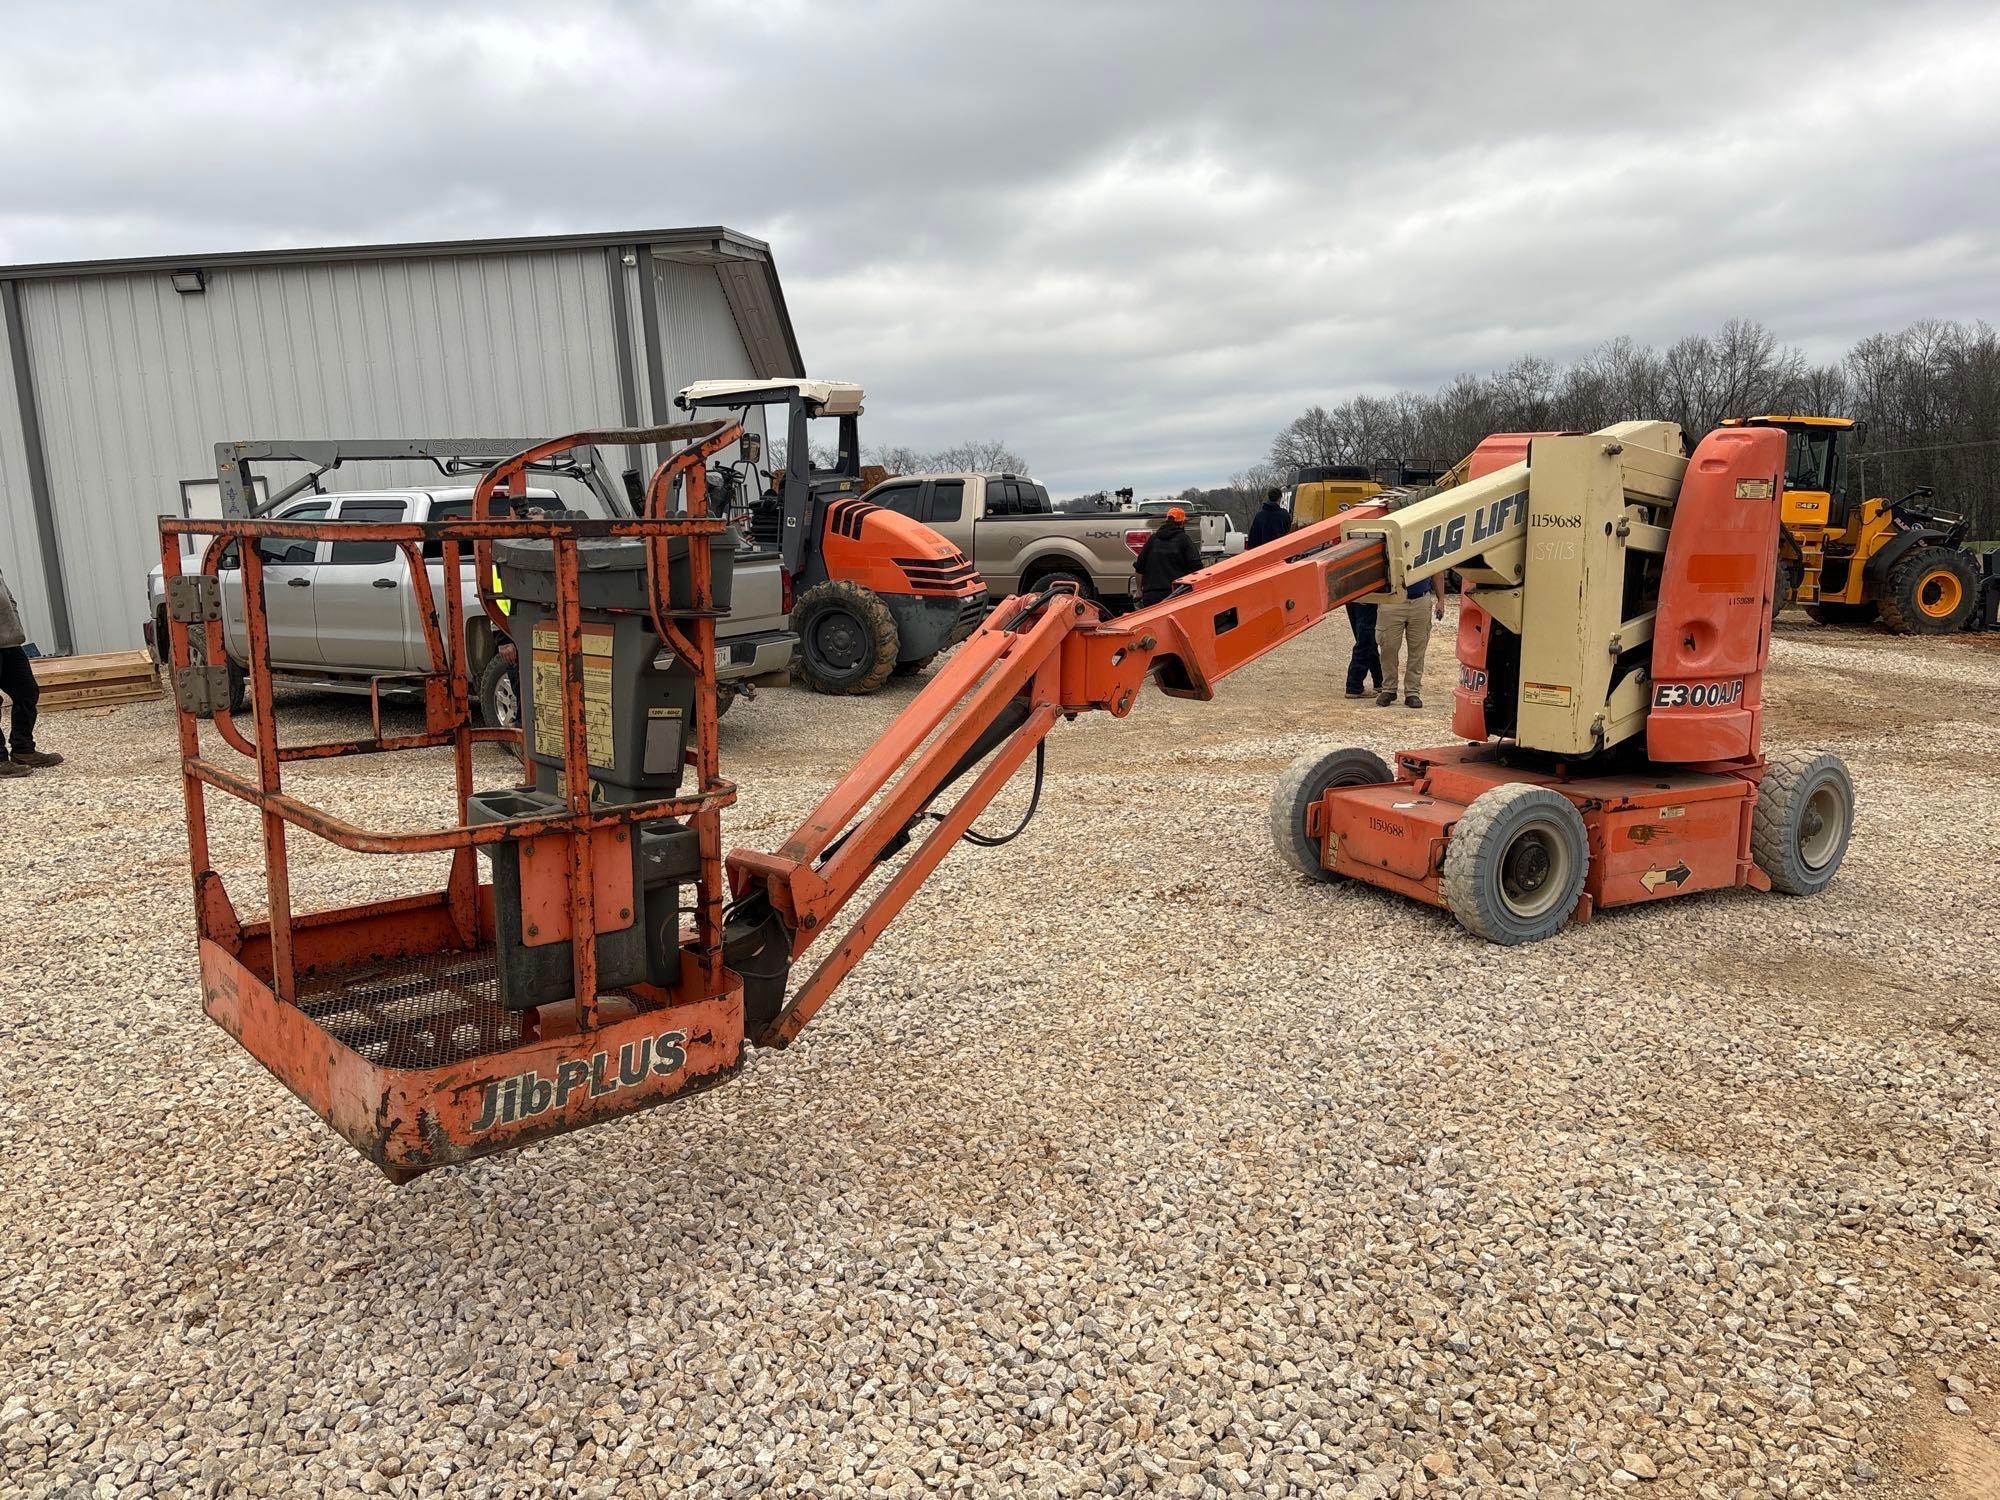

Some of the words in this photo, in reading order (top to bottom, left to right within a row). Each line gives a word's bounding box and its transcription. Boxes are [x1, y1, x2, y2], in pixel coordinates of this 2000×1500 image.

[433, 441, 519, 454] SKYJACK
[1412, 513, 1467, 570] JLG
[1470, 489, 1529, 546] LIFT
[1531, 513, 1582, 528] 1159688
[1653, 679, 1744, 708] E300AJP
[1369, 816, 1404, 838] 1159688
[470, 1029, 687, 1134] JibPLUS
